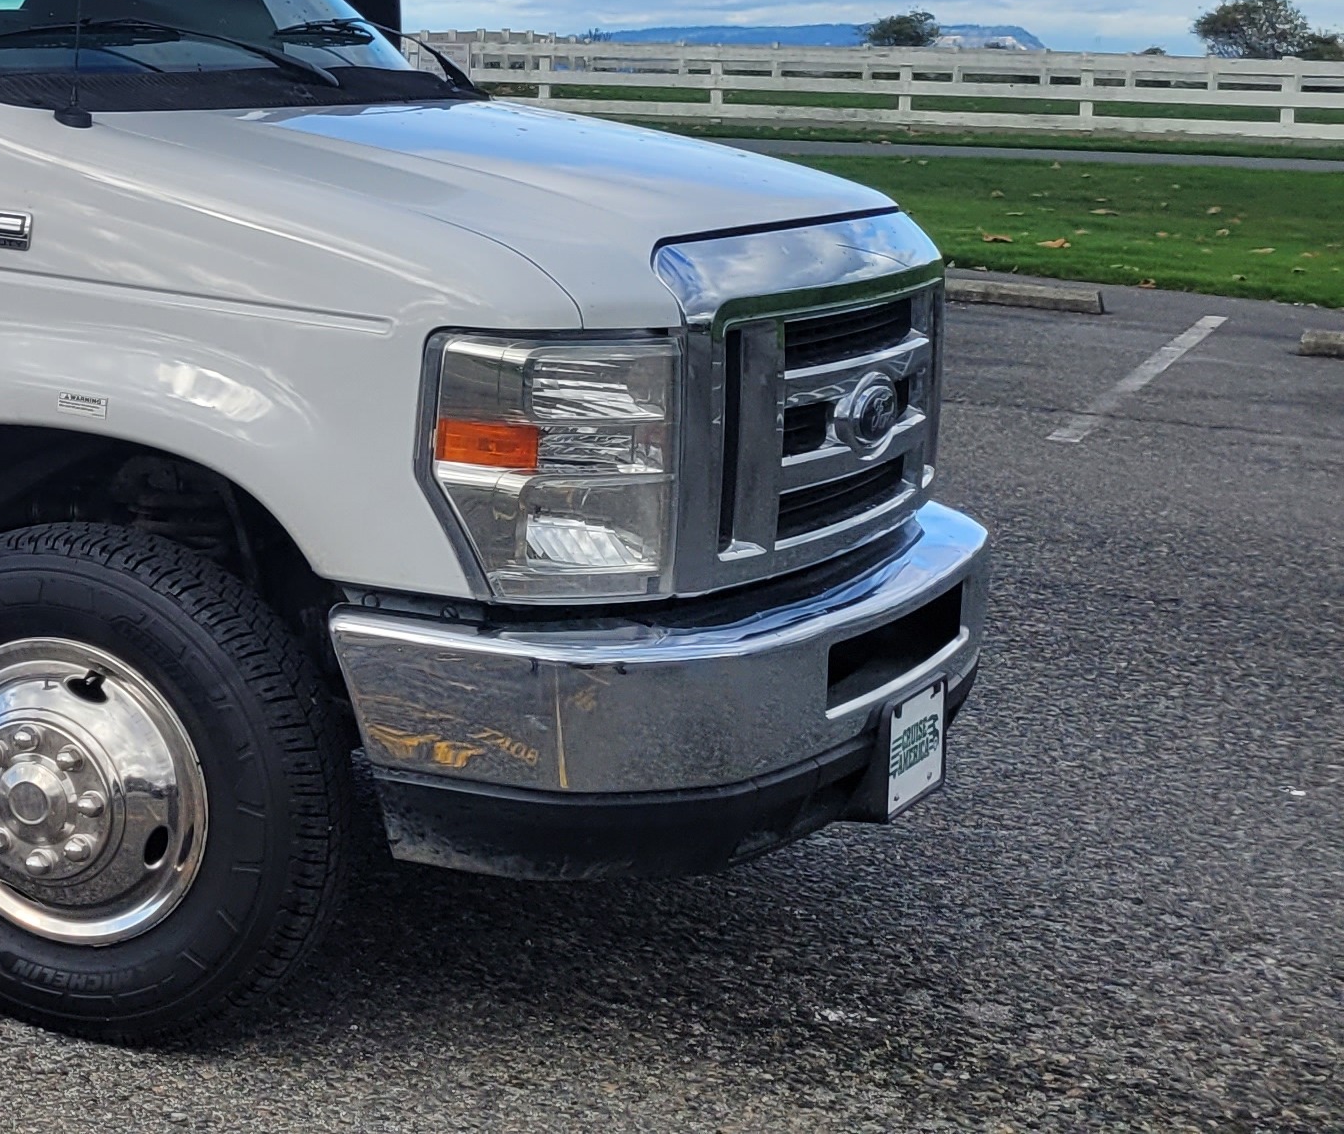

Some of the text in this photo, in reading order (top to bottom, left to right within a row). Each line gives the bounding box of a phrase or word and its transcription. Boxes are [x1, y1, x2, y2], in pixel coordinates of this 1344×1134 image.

[71, 394, 102, 405] WARNING
[902, 716, 929, 750] CRUISE
[898, 737, 930, 776] AMERICA
[13, 958, 134, 991] MICHELIN
